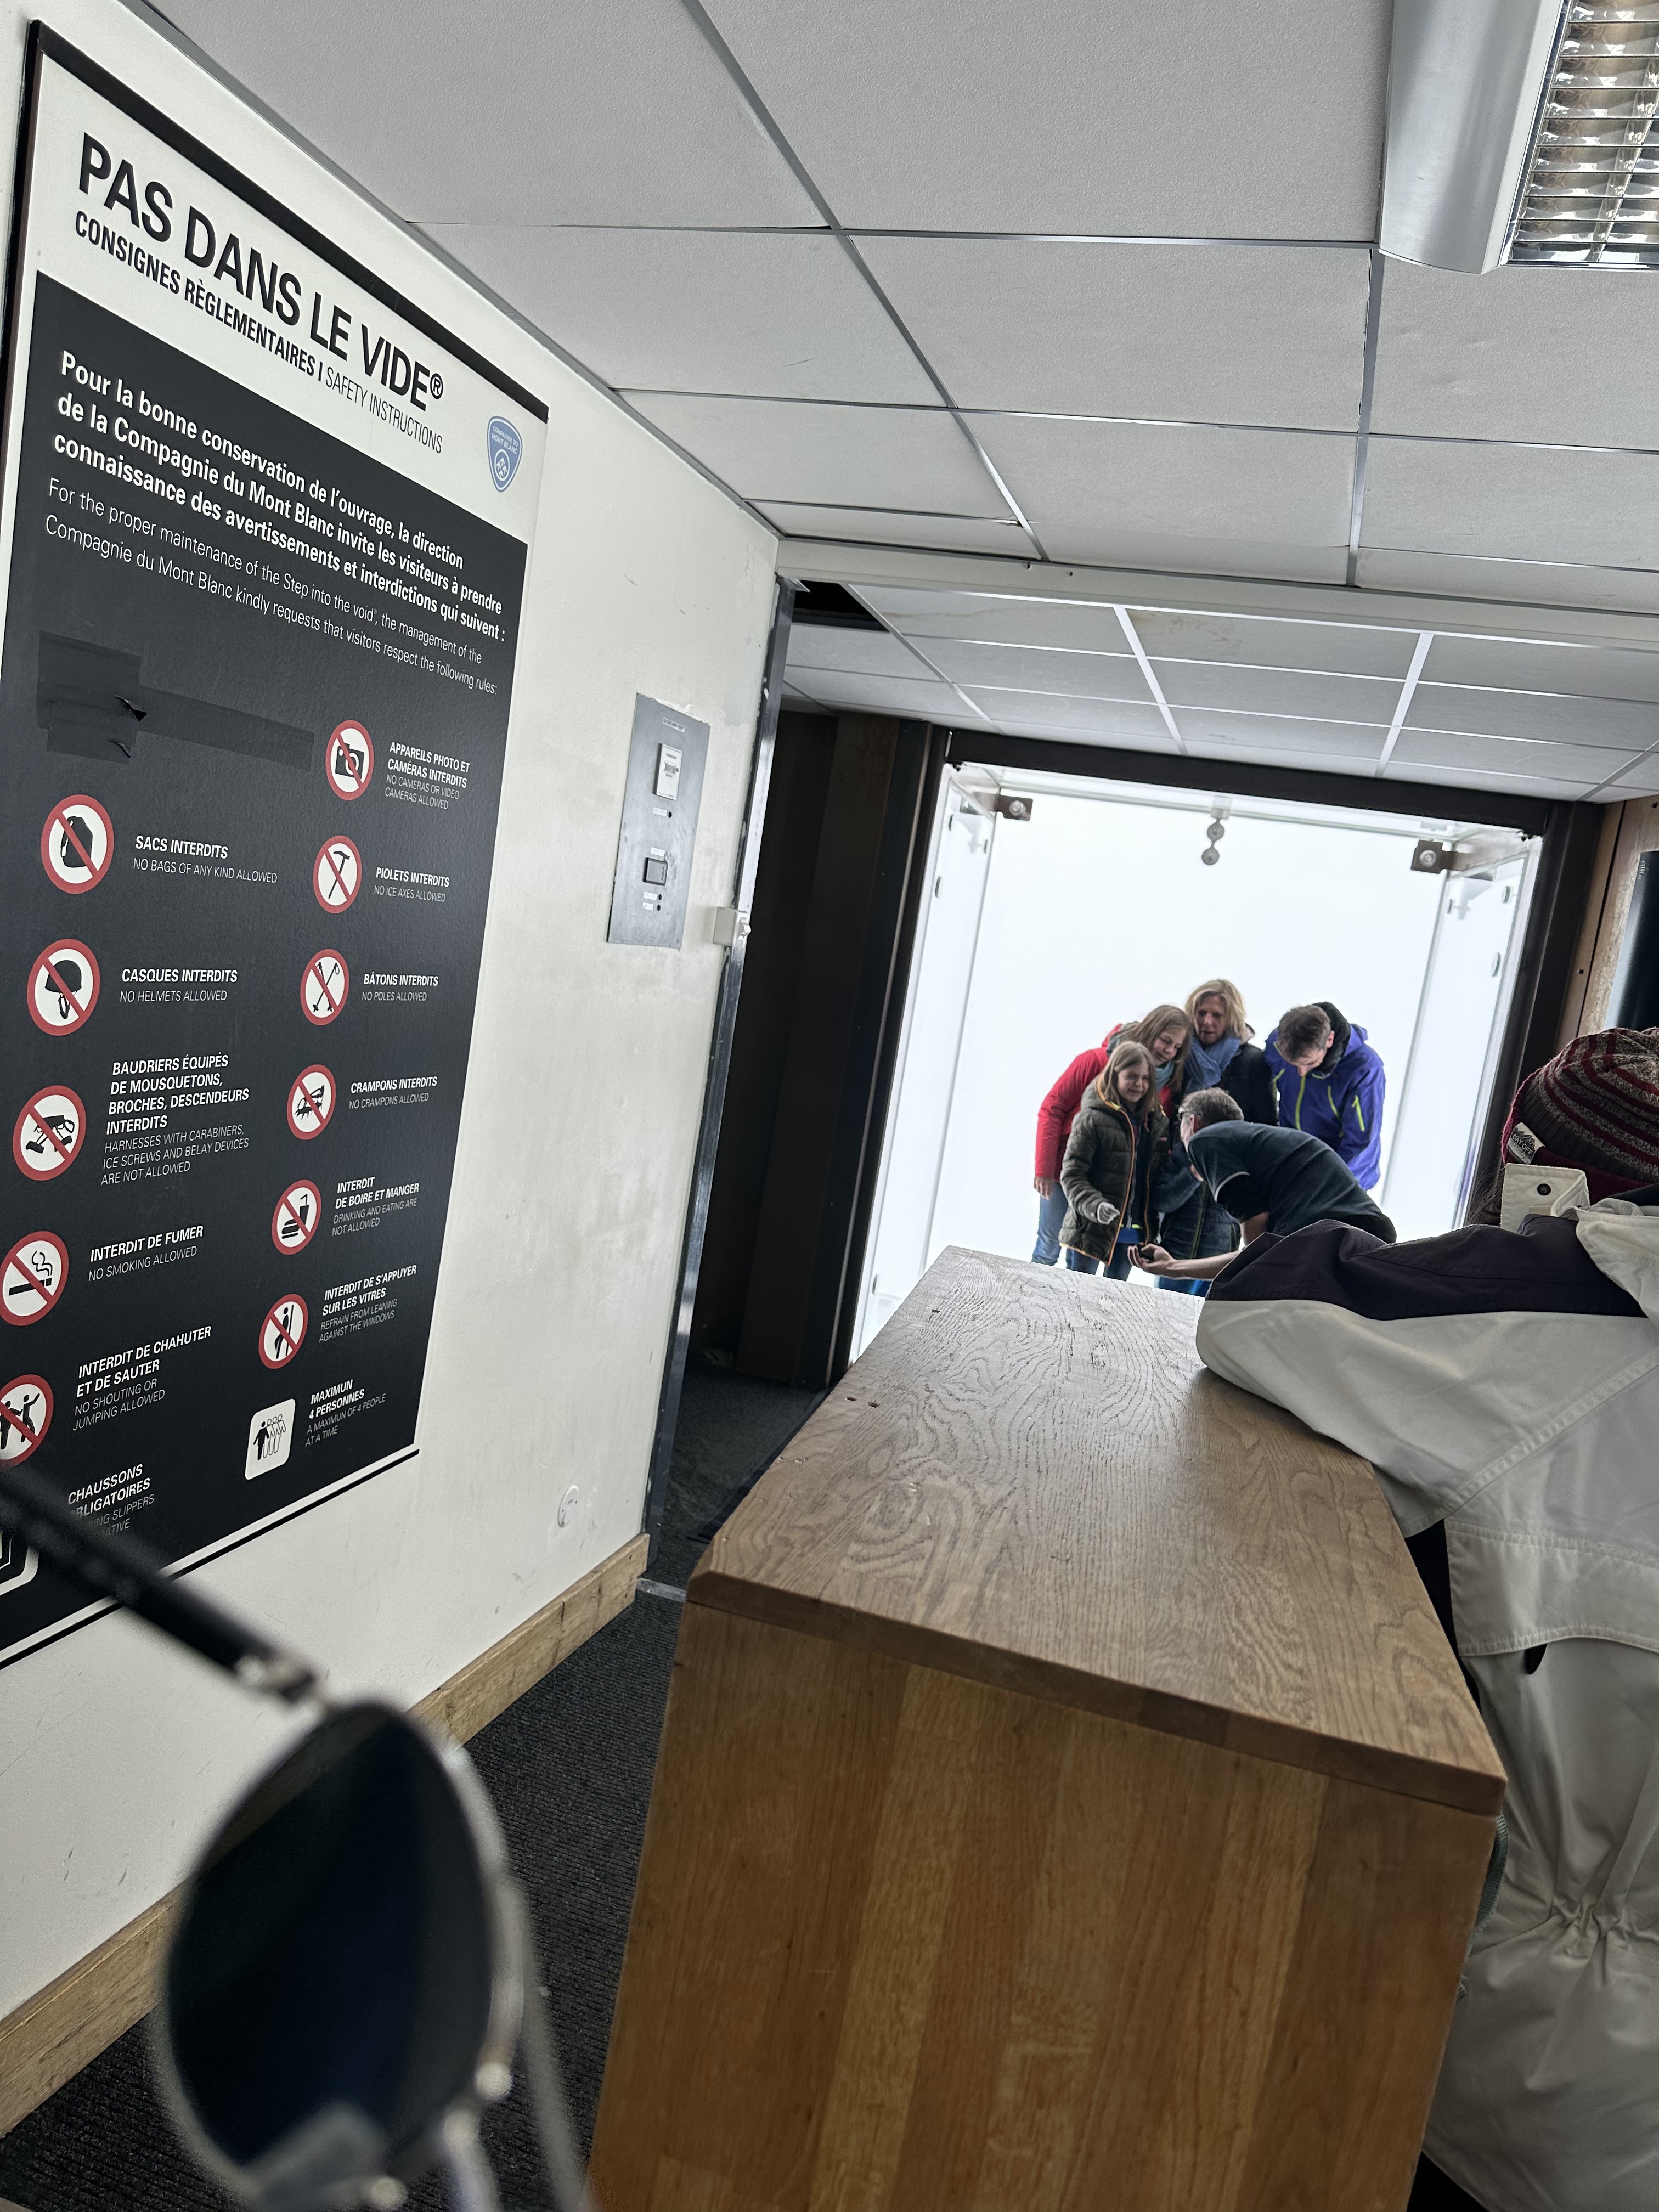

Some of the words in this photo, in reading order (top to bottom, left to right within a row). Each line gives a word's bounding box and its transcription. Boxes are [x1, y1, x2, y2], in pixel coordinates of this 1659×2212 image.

[78, 132, 173, 242] PAS
[184, 205, 301, 326] DANS
[310, 291, 352, 362] LE
[361, 323, 443, 412] VIDE®
[75, 211, 180, 294] CONSIGNES
[184, 278, 315, 376] RÈGLEMENTAIRES
[325, 366, 368, 407] SAFETY
[369, 393, 442, 454] INSTRUCTIONS
[492, 432, 504, 445] MONT
[504, 441, 518, 455] BLANC
[513, 438, 519, 447] DU
[61, 350, 111, 395] Pour
[116, 379, 133, 408] la
[139, 390, 197, 439] bonne
[202, 430, 304, 493] conservation
[309, 479, 326, 503] de
[330, 488, 395, 539] l'ouvrage,
[398, 522, 409, 543] la
[413, 531, 463, 569] direction
[58, 392, 83, 422] de
[90, 404, 108, 434] la
[114, 417, 218, 484] Compagnie
[223, 471, 244, 496] du
[249, 480, 291, 518] Mont
[295, 502, 334, 537] Blanc
[337, 522, 375, 556] invite
[377, 541, 396, 566] les
[399, 554, 449, 590] visiteurs
[451, 576, 458, 595] à
[460, 585, 501, 614] prendre
[54, 434, 186, 505] connaissance
[191, 490, 221, 520] des
[225, 510, 340, 571] avertissements
[343, 561, 358, 579] et
[360, 563, 437, 612] interdictions
[440, 603, 459, 622] qui
[460, 612, 499, 640] suivent
[49, 477, 75, 504] For
[80, 492, 104, 516] the
[109, 506, 156, 536] proper
[160, 527, 242, 570] maintenance
[246, 560, 259, 576] of
[262, 565, 280, 585] the
[283, 573, 308, 599] Step
[311, 584, 331, 605] into
[334, 595, 350, 613] the
[381, 613, 396, 630] the
[399, 623, 456, 654] management
[458, 645, 467, 658] of
[469, 648, 482, 664] the
[46, 515, 132, 562] Compagnie
[137, 550, 154, 571] du
[159, 556, 194, 585] Mont
[198, 571, 232, 599] Blanc
[236, 585, 270, 615] kindly
[273, 603, 320, 630] requests
[324, 619, 343, 639] that
[346, 628, 381, 652] visitors
[383, 644, 418, 666] respect
[420, 655, 435, 672] the
[437, 660, 474, 689] following
[389, 742, 432, 763] APPAREILS
[433, 753, 459, 770] PHOTO
[460, 761, 470, 773] ET
[388, 758, 427, 778] CAMÉRAS
[428, 769, 467, 788] INTERDITS
[135, 835, 167, 851] SACS
[170, 839, 228, 859] INTERDITS
[133, 857, 148, 870] NO
[151, 859, 177, 873] BAGS
[179, 862, 191, 874] OF
[193, 864, 212, 876] ANY
[214, 866, 235, 878] KIND
[236, 869, 278, 883] ALLOWED
[376, 867, 409, 882] PIOLETS
[410, 872, 449, 887] INTERDITS
[122, 968, 179, 982] CASQUES
[182, 969, 238, 982] INTERDITS
[363, 971, 398, 985] BÂTONS
[399, 975, 438, 986] INTERDITS
[120, 991, 135, 1002] NO
[138, 990, 181, 1001] HELMETS
[183, 990, 227, 1001] ALLOWED
[362, 991, 373, 1001] NO
[374, 991, 395, 1001] POLES
[396, 991, 427, 1001] ALLOWED
[112, 1058, 179, 1075] BAUDRIERS
[182, 1052, 228, 1070] ÉQUIPÉS
[110, 1081, 127, 1095] DE
[129, 1073, 223, 1093] MOUSQUETONS,
[351, 1079, 397, 1093] CRAMPONS
[398, 1076, 437, 1089] INTERDITS
[109, 1096, 167, 1115] BROCHES,
[170, 1088, 249, 1108] DESCENDEURS
[349, 1099, 359, 1109] NO
[361, 1095, 398, 1108] CRAMPONS
[398, 1092, 429, 1103] ALLOWED
[105, 1135, 161, 1153] HARNESSES
[163, 1132, 187, 1144] WITH
[189, 1124, 244, 1141] CARABINERS,
[106, 1115, 167, 1135] INTERDITS
[103, 1156, 119, 1169] ICE
[121, 1150, 161, 1166] SCREWS
[162, 1147, 183, 1160] AND
[185, 1143, 213, 1156] BELAY
[214, 1137, 249, 1152] DEVICES
[1522, 1143, 1533, 1154] OFF
[100, 1172, 121, 1186] ARE
[123, 1168, 144, 1181] NOT
[145, 1161, 190, 1178] ALLOWED
[337, 1176, 375, 1193] INTERDIT
[335, 1197, 347, 1209] DE
[348, 1192, 373, 1206] BOIRE
[374, 1189, 385, 1201] ET
[386, 1183, 419, 1198] MANGER
[90, 1238, 145, 1262] INTERDIT
[147, 1234, 162, 1249] DE
[165, 1225, 203, 1245] FUMER
[88, 1268, 104, 1281] NO
[106, 1256, 150, 1277] SMOKING
[153, 1246, 197, 1265] ALLOWED
[324, 1280, 362, 1300] INTERDIT
[363, 1277, 374, 1289] DE
[375, 1265, 417, 1285] S'APPUYER
[322, 1301, 341, 1316] SUR
[342, 1296, 357, 1310] LES
[359, 1287, 386, 1304] VITRES
[78, 1350, 133, 1379] INTERDIT
[135, 1344, 150, 1360] DE
[153, 1325, 211, 1354] CHAHUTER
[76, 1381, 93, 1397] ET
[94, 1375, 111, 1391] DE
[114, 1359, 160, 1384] SAUTER
[311, 1379, 353, 1404] MAXIMUN
[72, 1406, 117, 1431] JUMPING
[119, 1389, 165, 1414] ALLOWED
[75, 1401, 90, 1415] NO
[92, 1383, 142, 1409] SHOUTING
[144, 1378, 157, 1391] OR
[308, 1409, 314, 1419] 4
[315, 1388, 364, 1417] PERSONNES
[68, 1464, 143, 1504] CHAUSSONS
[112, 1493, 155, 1521] SLIPPERS
